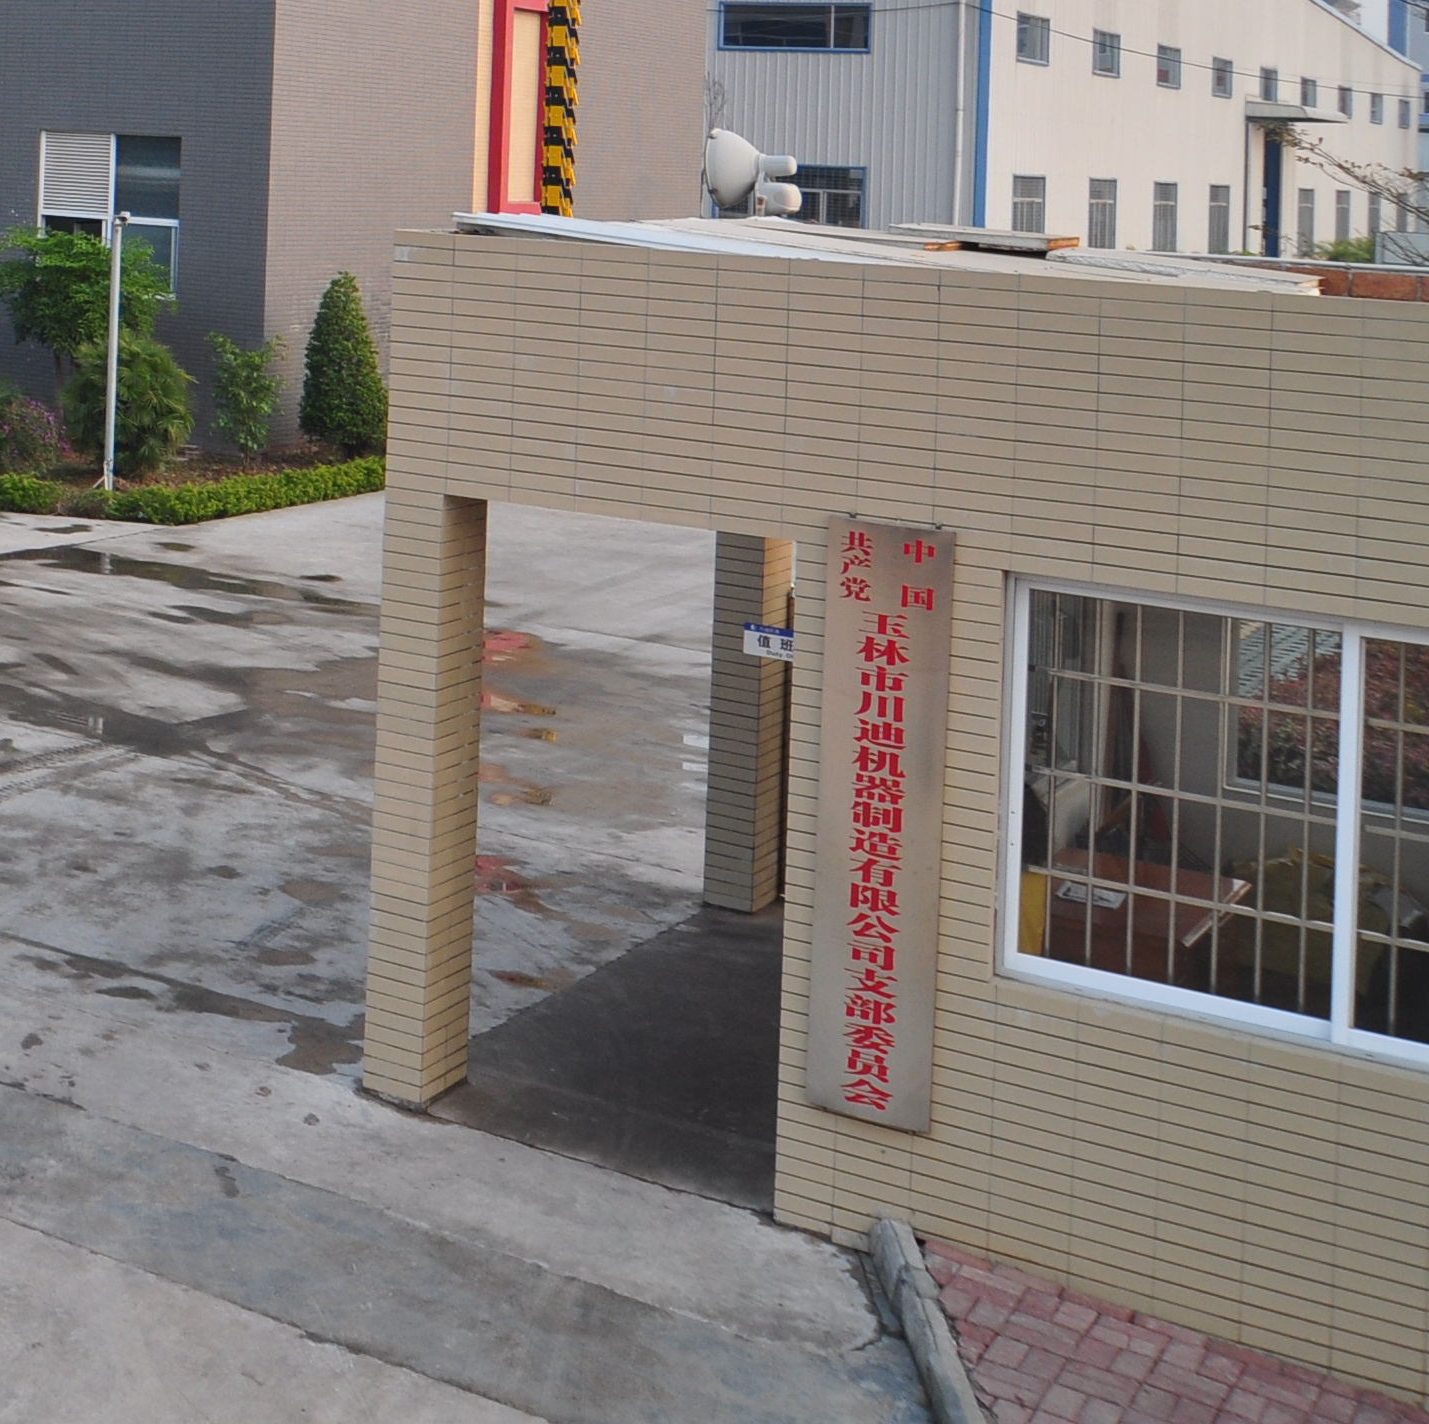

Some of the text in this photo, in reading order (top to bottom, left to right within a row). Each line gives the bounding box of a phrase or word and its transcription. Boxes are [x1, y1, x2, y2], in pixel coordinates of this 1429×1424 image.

[840, 530, 874, 602] 共产党
[901, 539, 936, 611] 中国
[840, 610, 911, 1111] 玉林市川迪机器制造有限公司支部委员会
